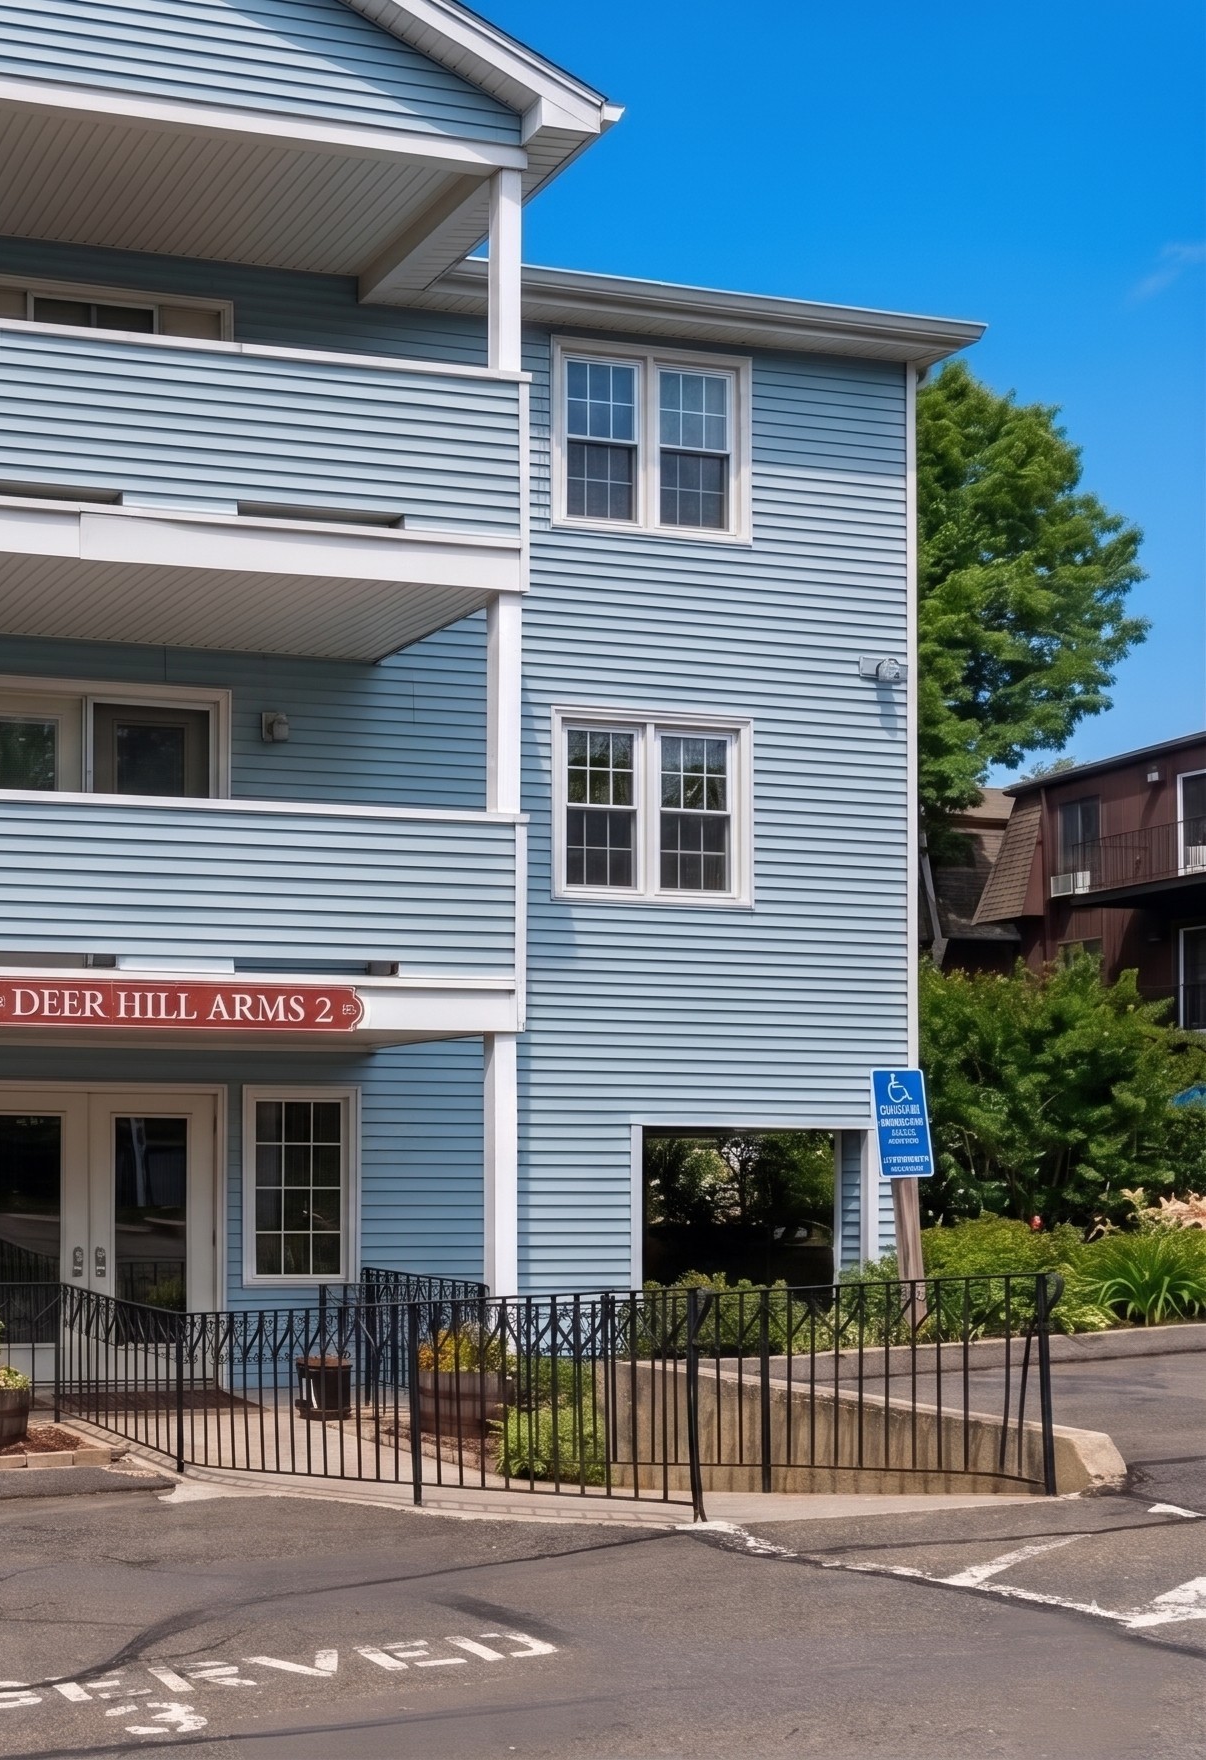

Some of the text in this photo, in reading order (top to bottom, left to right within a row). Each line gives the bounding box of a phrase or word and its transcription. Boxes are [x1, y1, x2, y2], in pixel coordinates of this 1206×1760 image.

[11, 988, 334, 1023] DEER HILL ARMS 2
[104, 1701, 209, 1735] 3
